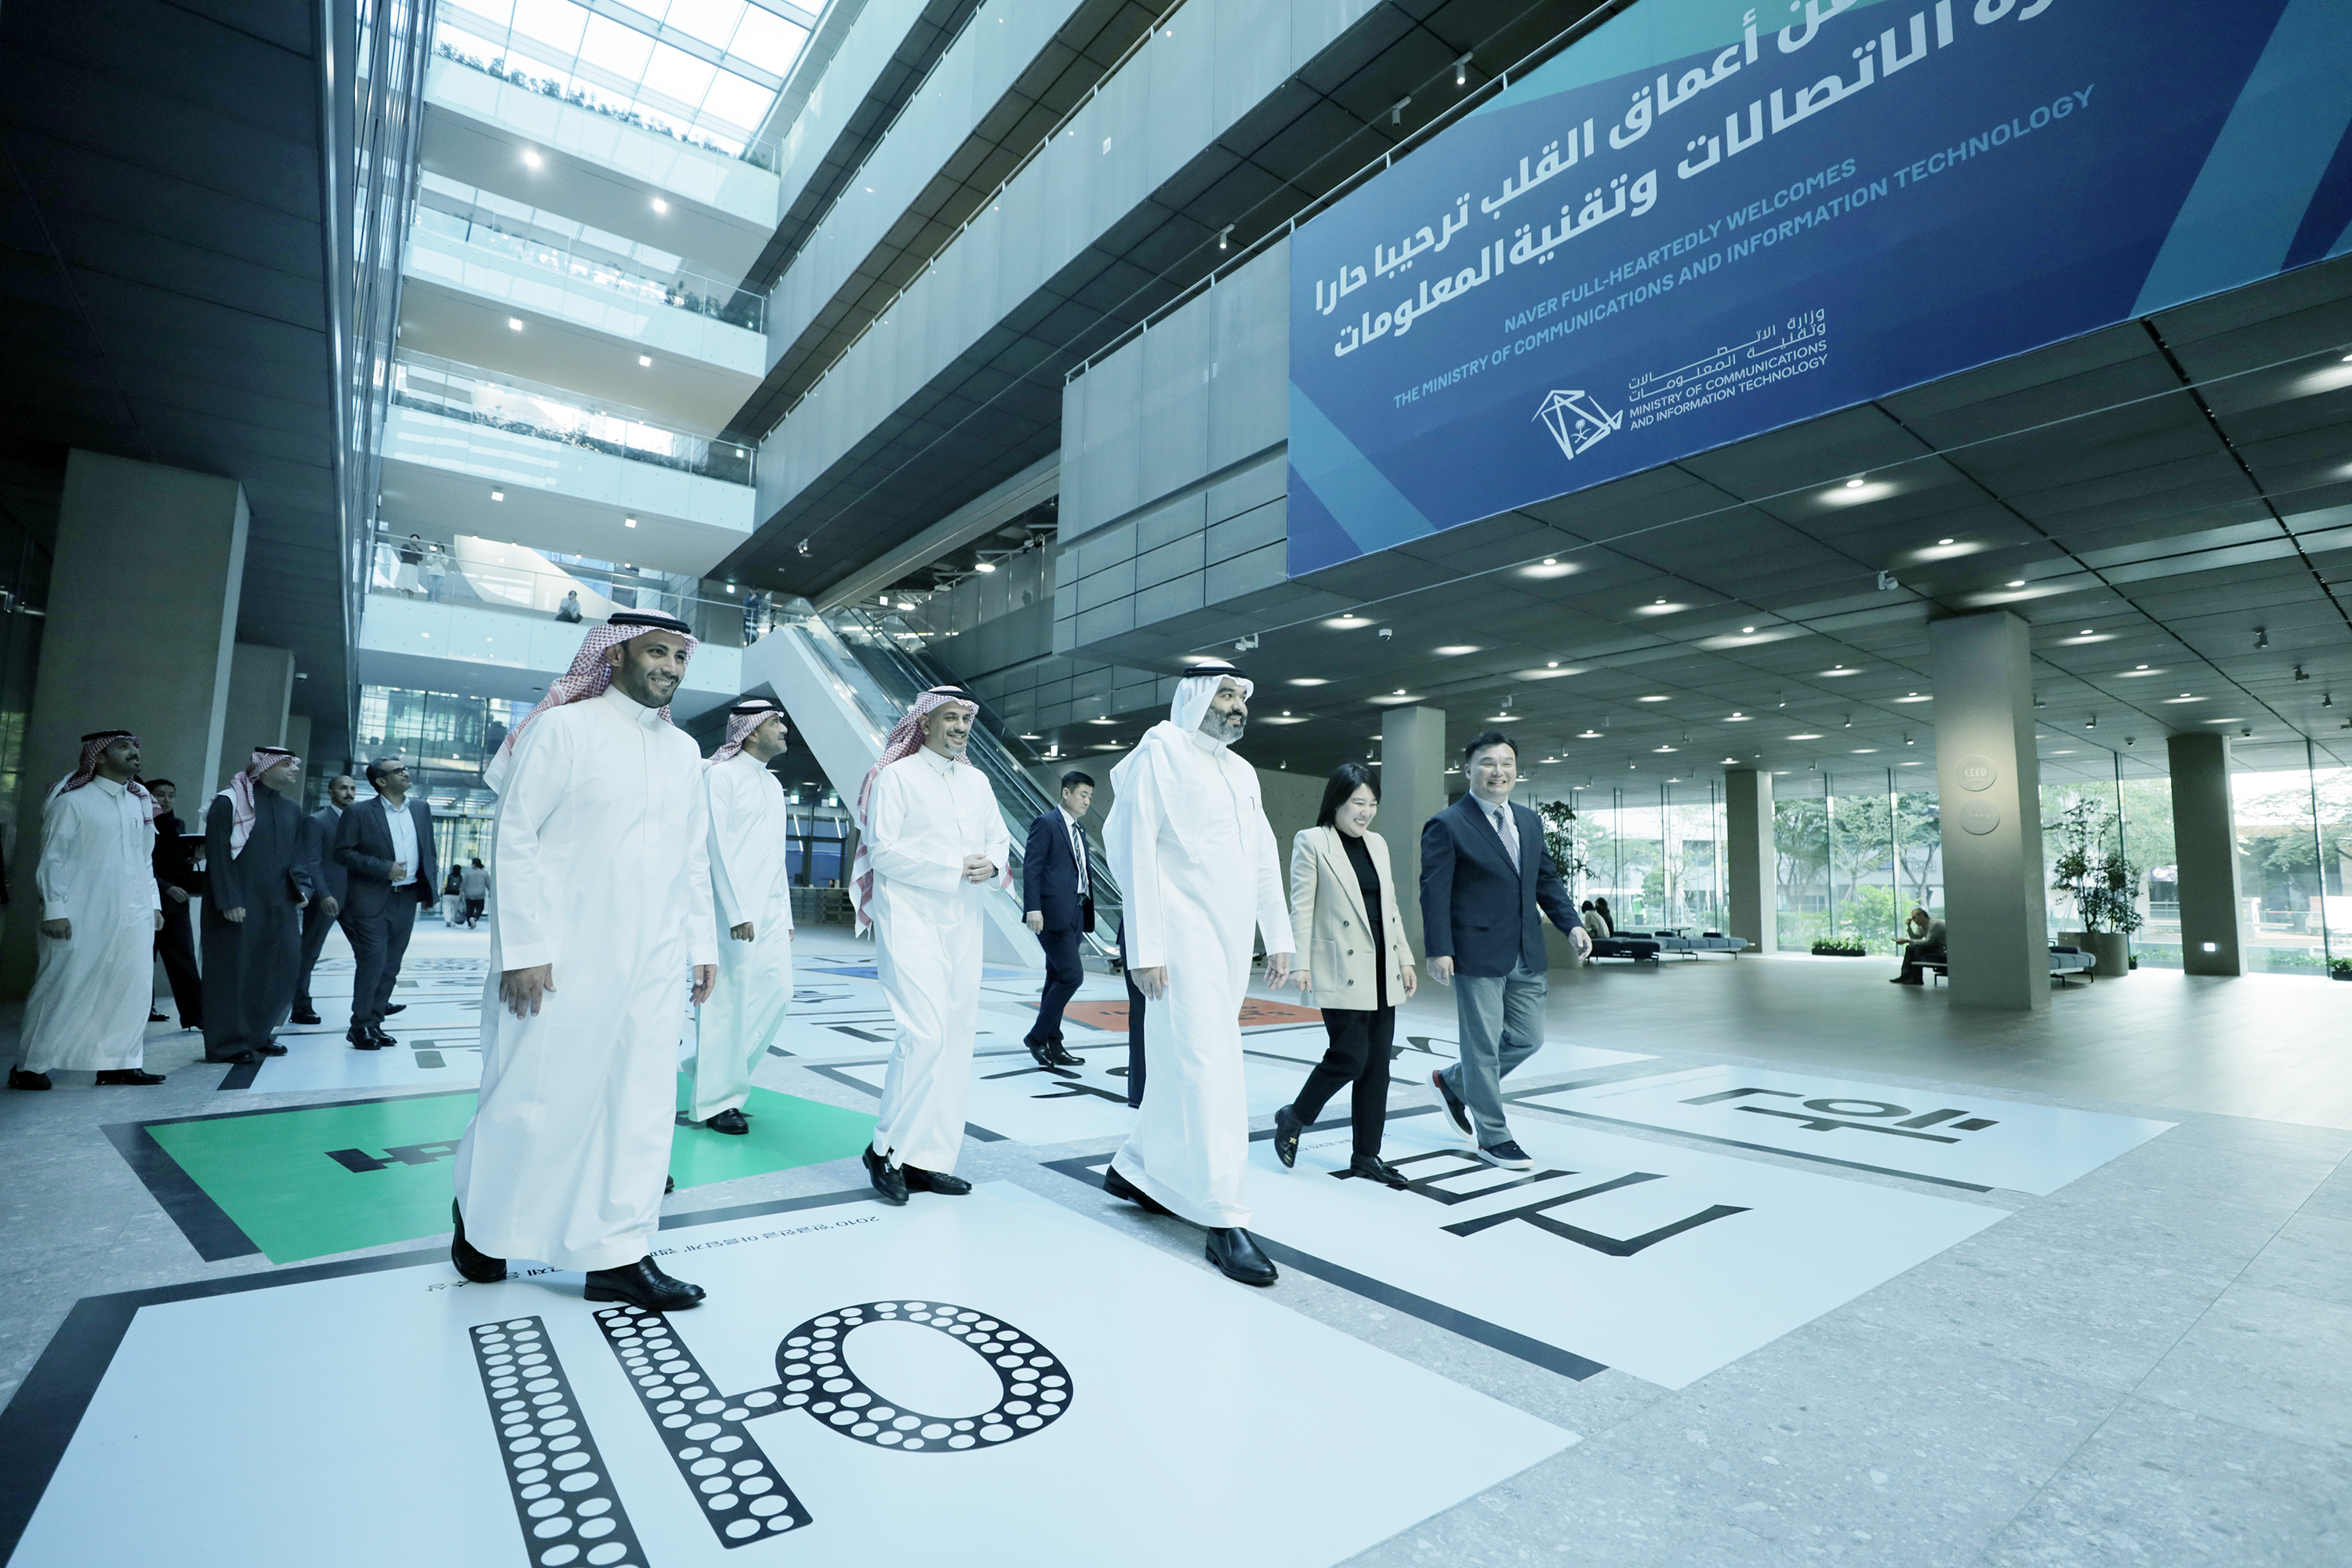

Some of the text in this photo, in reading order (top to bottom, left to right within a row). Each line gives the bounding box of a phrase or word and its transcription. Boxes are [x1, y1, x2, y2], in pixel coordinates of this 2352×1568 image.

[1609, 7, 1759, 150] أعماق
[1334, 0, 1955, 358] الاتصالات وتقنية المعلومات
[1481, 118, 1595, 220] القلب
[1374, 192, 1470, 279] ترحيبا
[1393, 83, 2095, 408] THE MINISTRY OF COMMUNICATIONS AND INFORMATION TECHNOLOGY
[1504, 158, 1857, 333] NAVER FULL-HEARTEDLY WELCOMES
[1316, 265, 1367, 315] حارا
[1787, 308, 1825, 329] وزارة
[1629, 339, 1827, 419] MINISTRY OF COMMUNICATIONS
[1630, 354, 1828, 431] AND INFORMATION TECHNOLOGY
[1965, 768, 1987, 777] LEED
[836, 1215, 880, 1229] 2010
